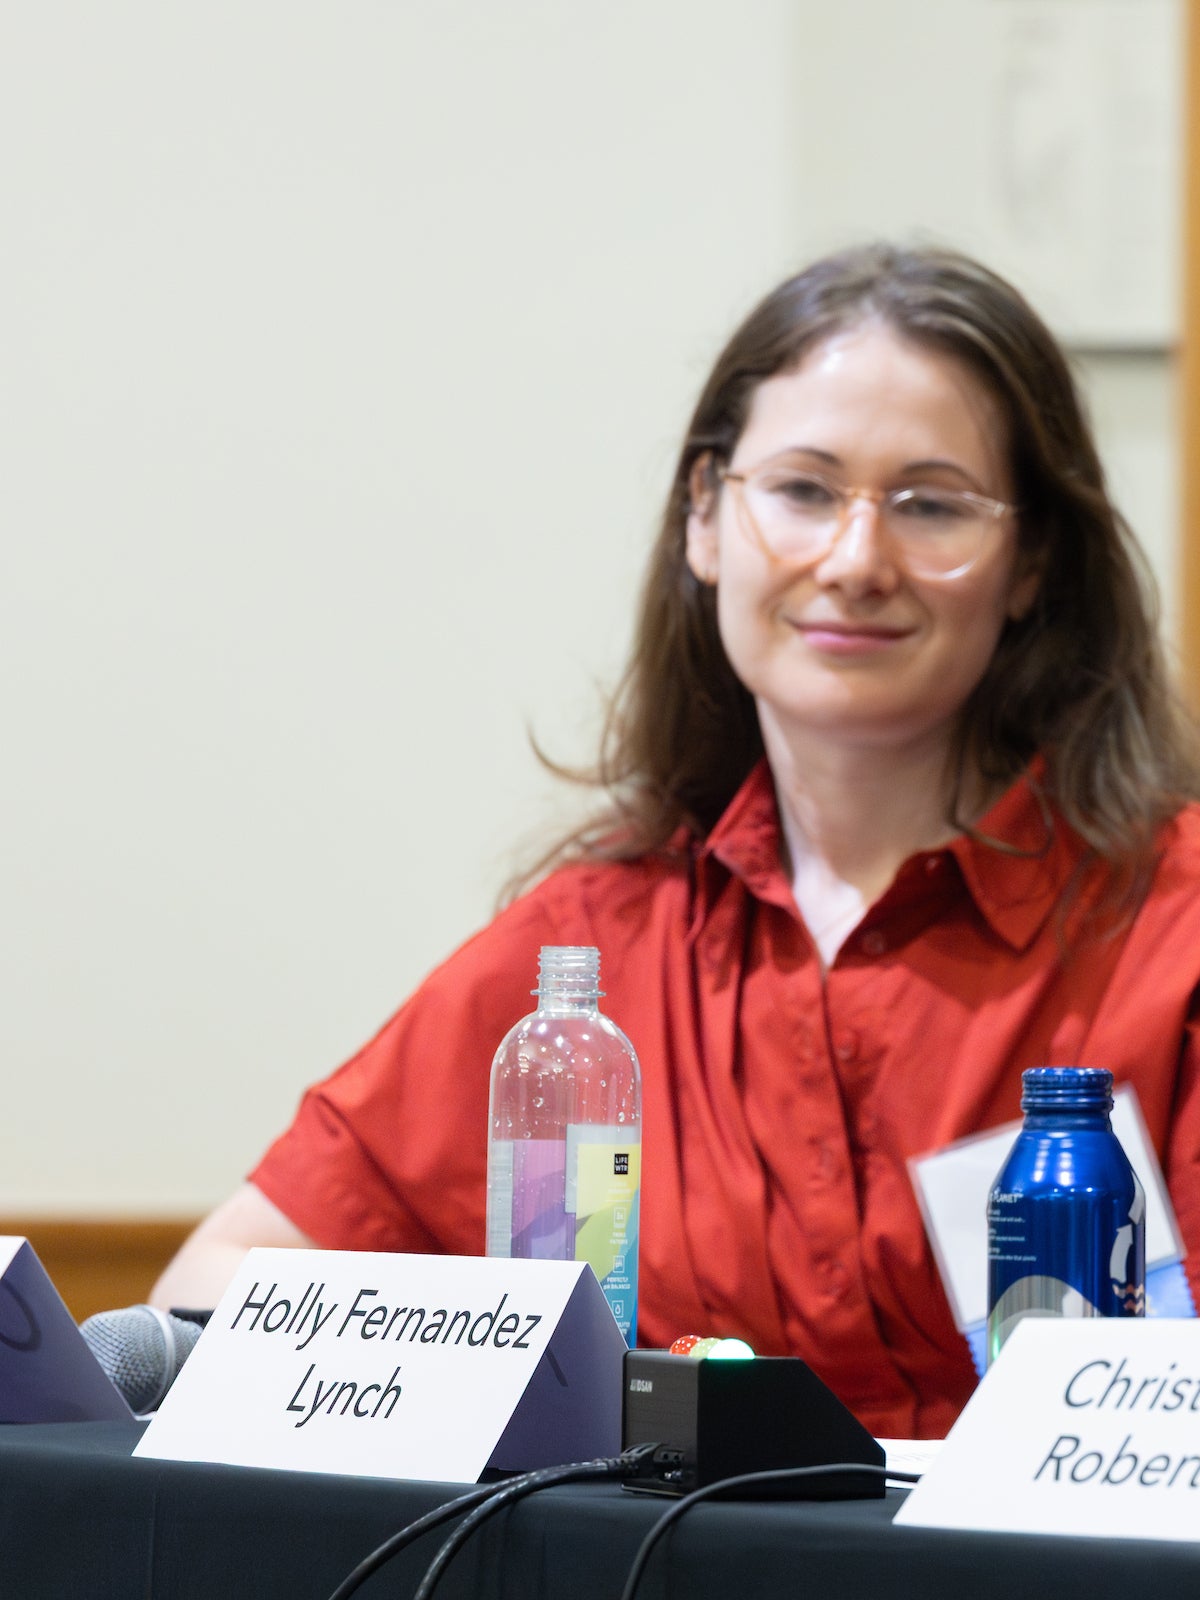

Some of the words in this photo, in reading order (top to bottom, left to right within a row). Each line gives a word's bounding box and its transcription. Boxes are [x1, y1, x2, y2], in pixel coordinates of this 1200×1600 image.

[615, 1156, 628, 1164] LIFE
[615, 1164, 628, 1172] WTR
[231, 1282, 338, 1351] Holly
[337, 1289, 542, 1350] Fernandez
[286, 1363, 402, 1428] Lynch
